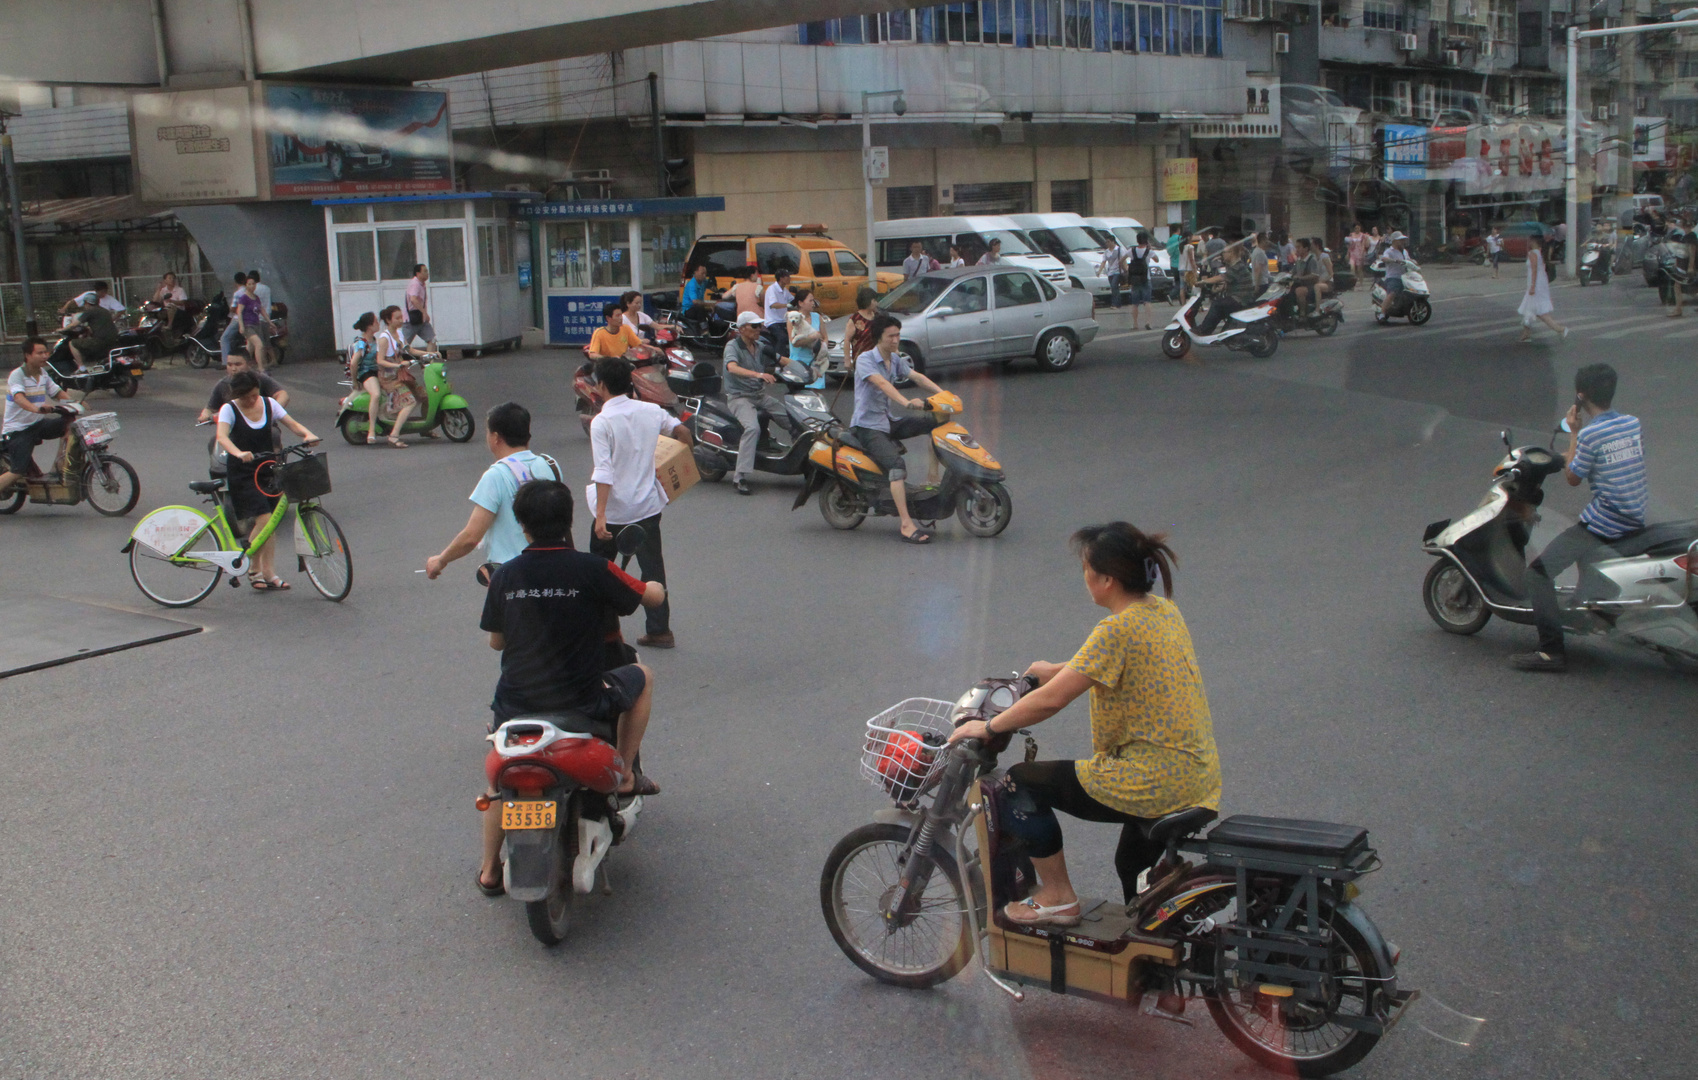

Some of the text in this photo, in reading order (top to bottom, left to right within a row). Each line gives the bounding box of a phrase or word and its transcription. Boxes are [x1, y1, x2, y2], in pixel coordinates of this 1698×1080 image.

[505, 588, 580, 600] 耐磨达刹车片
[505, 812, 553, 827] 33538
